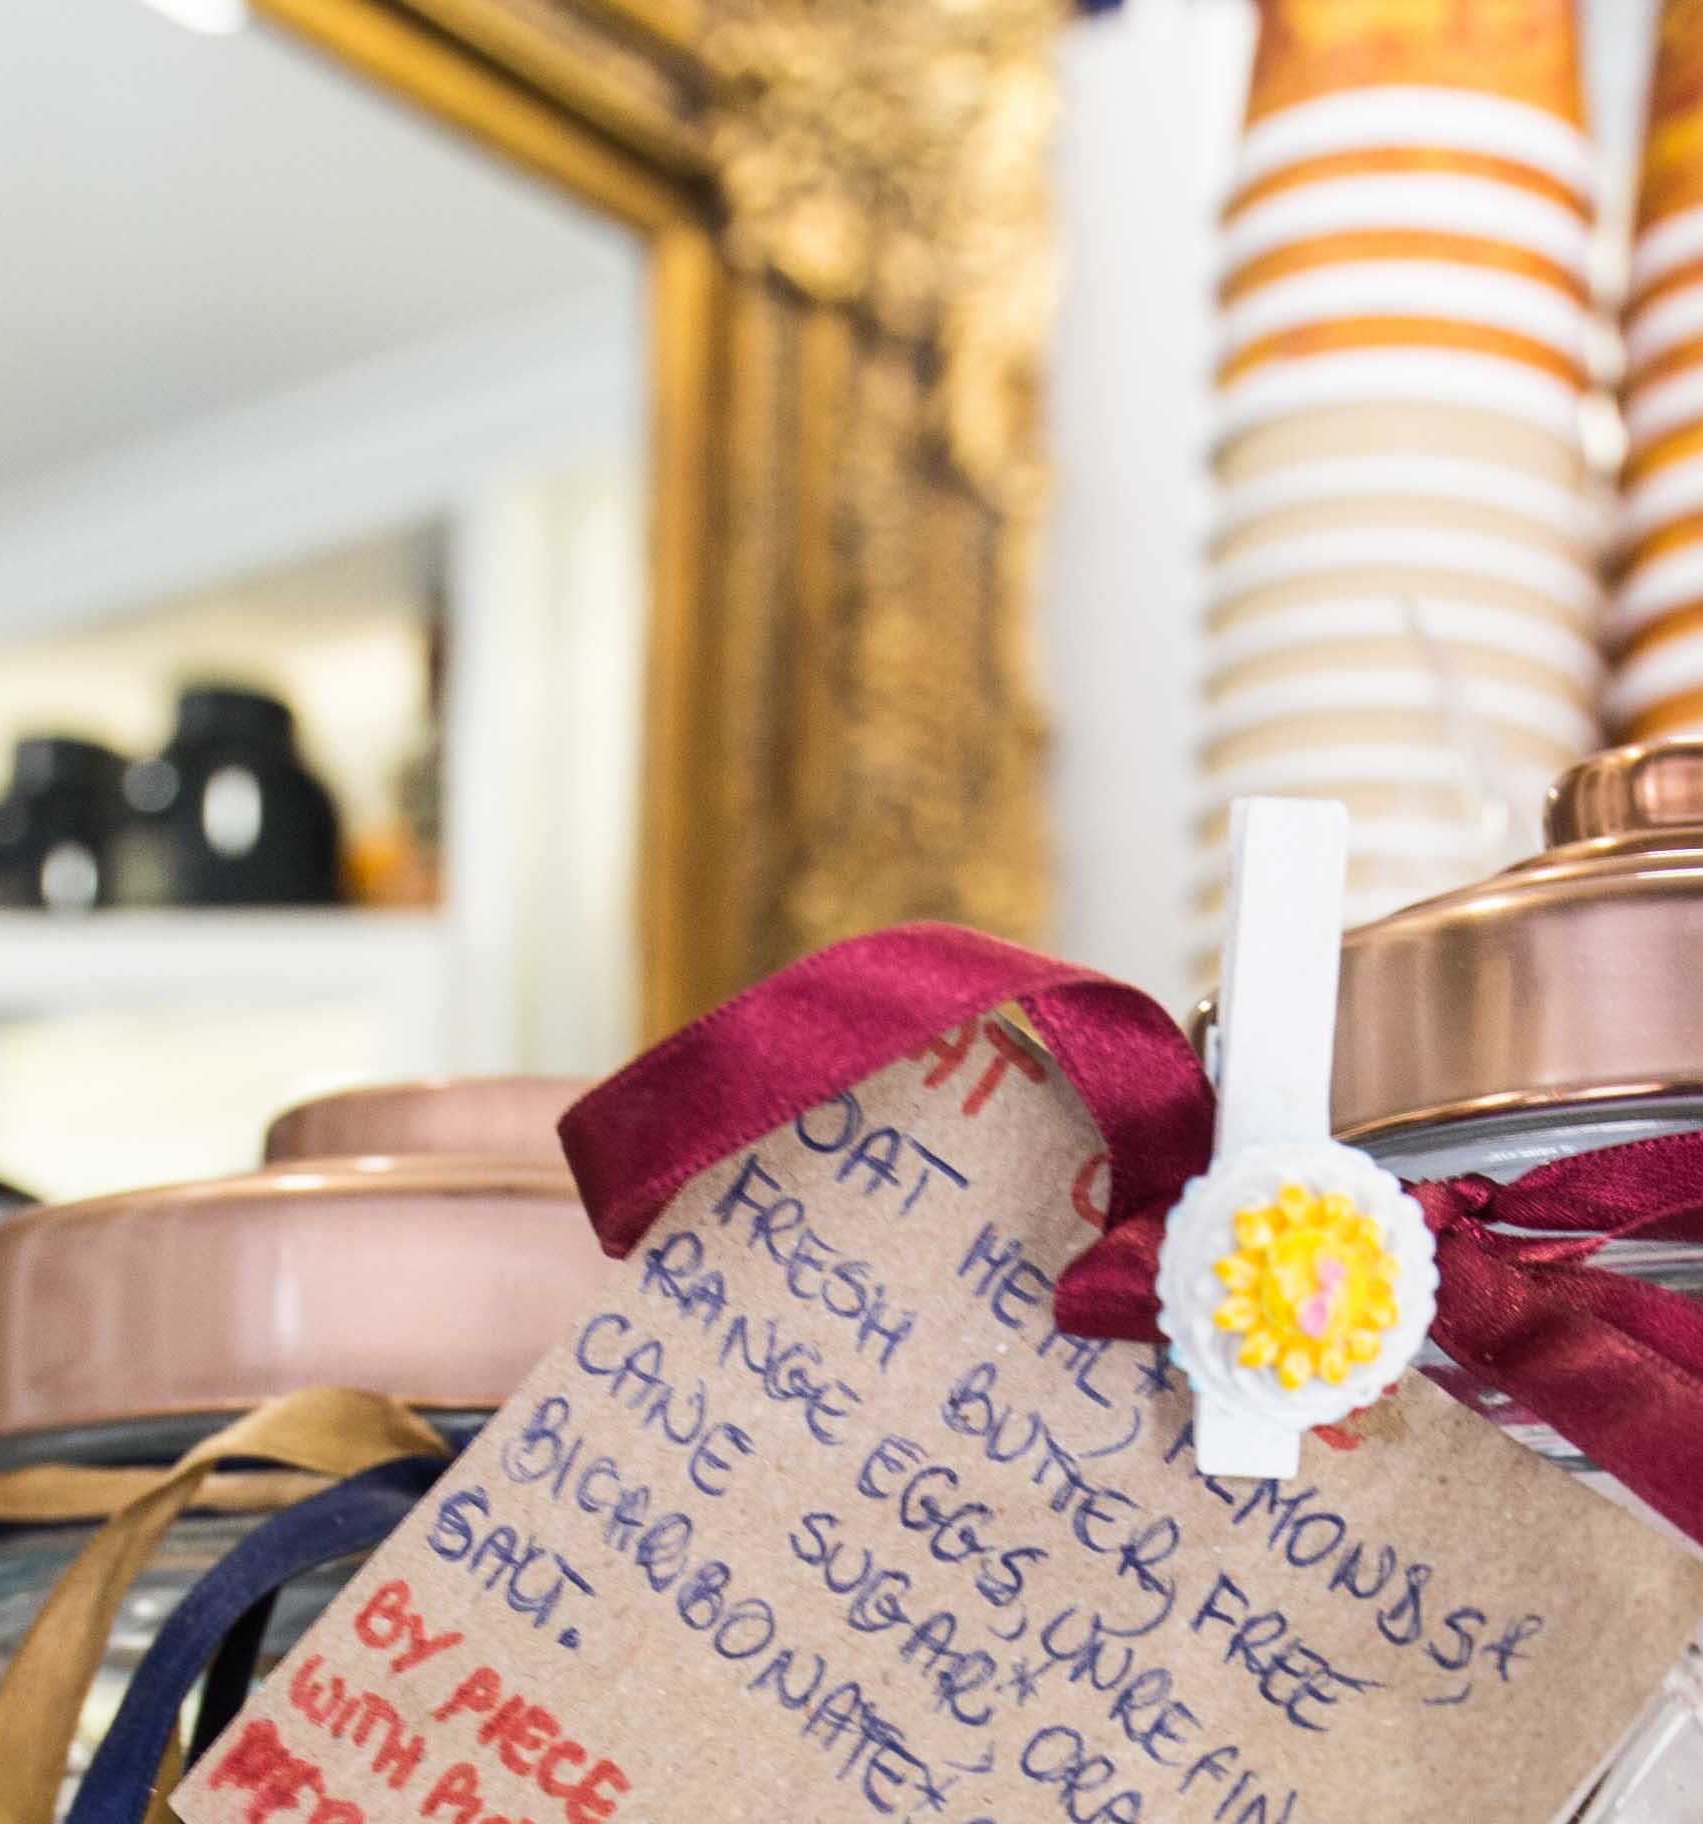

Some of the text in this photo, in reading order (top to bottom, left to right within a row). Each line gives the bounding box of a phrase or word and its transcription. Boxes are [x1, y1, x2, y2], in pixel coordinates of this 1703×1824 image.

[576, 1313, 755, 1497] CANE
[639, 1231, 860, 1446] RANGE
[710, 1153, 914, 1373] FRESH
[1190, 1572, 1386, 1732] FREE
[354, 1578, 465, 1674] BY
[288, 1653, 426, 1790] WITH
